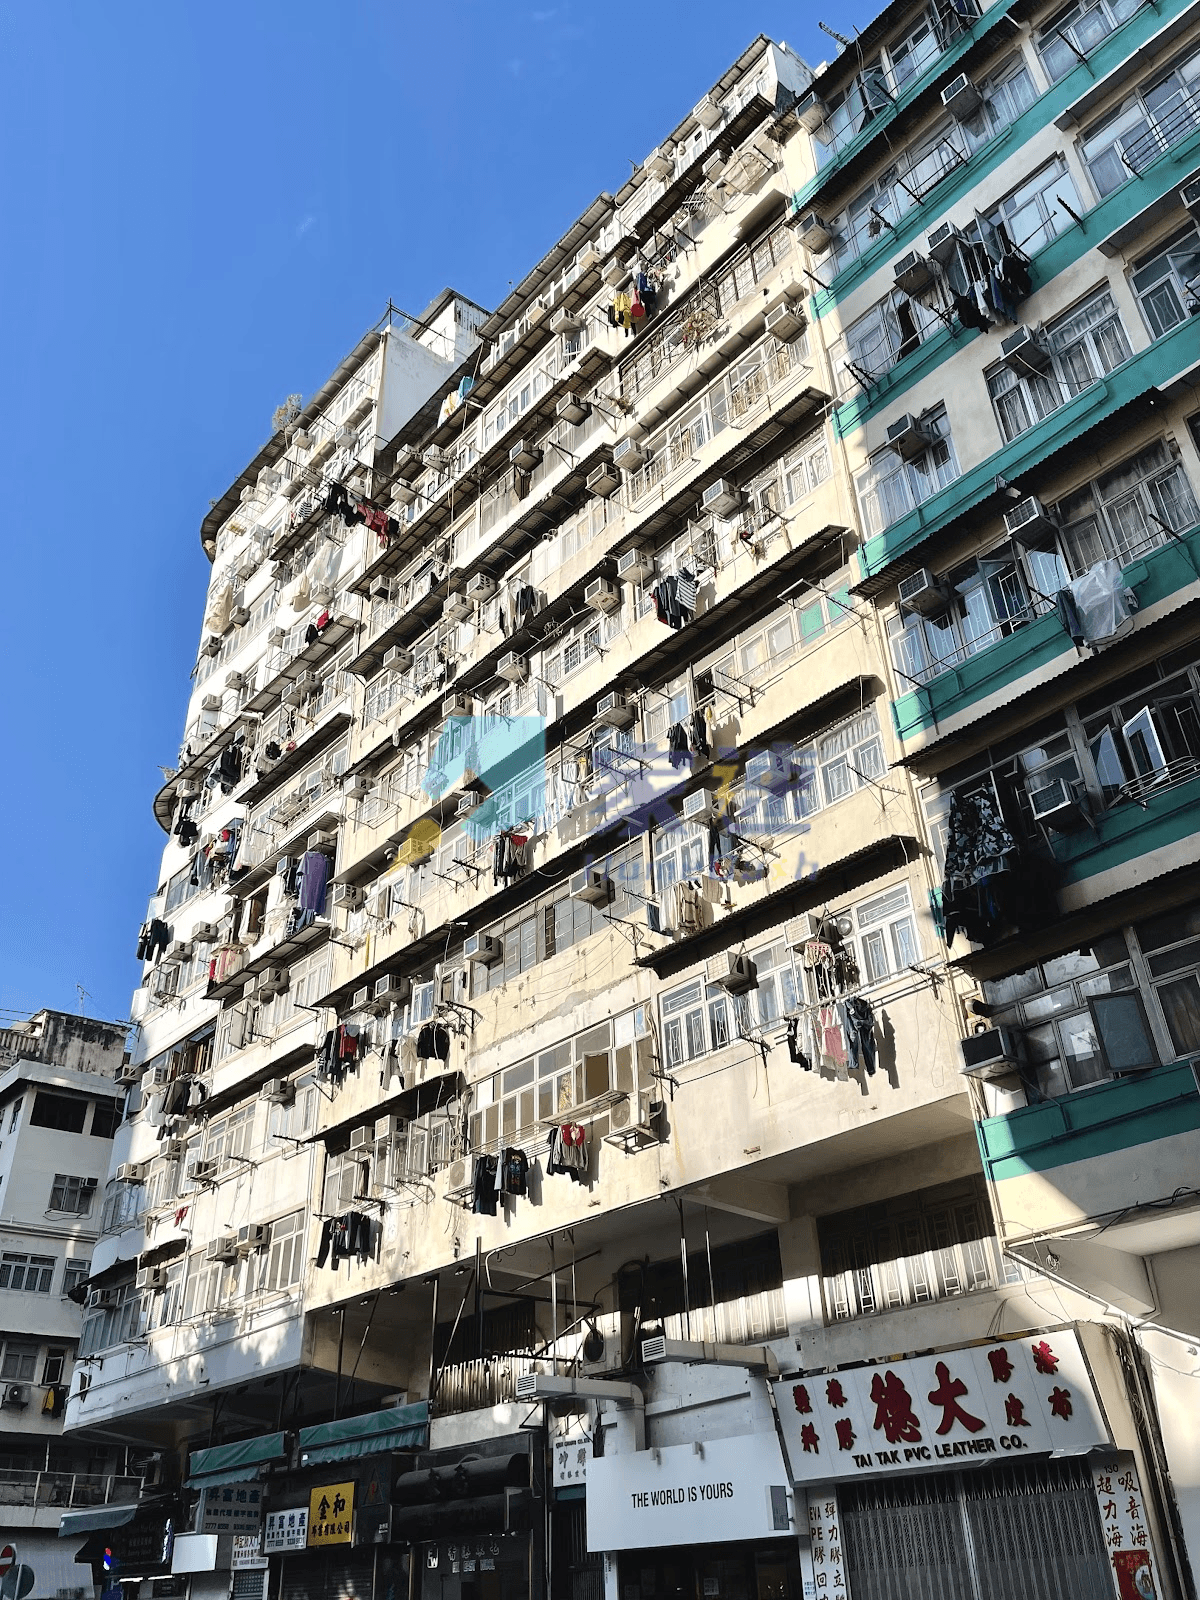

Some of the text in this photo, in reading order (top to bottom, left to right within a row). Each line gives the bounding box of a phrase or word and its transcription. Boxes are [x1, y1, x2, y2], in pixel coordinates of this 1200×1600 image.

[852, 1434, 1028, 1468] TAI TAK PVC LEATHER CO.
[1104, 1464, 1119, 1474] 130
[631, 1482, 734, 1508] THE WORLD IS YOURS
[809, 1506, 822, 1521] EVA
[1097, 1474, 1123, 1547] 超力海
[1117, 1471, 1148, 1546] 吸音海
[811, 1527, 823, 1541] PE
